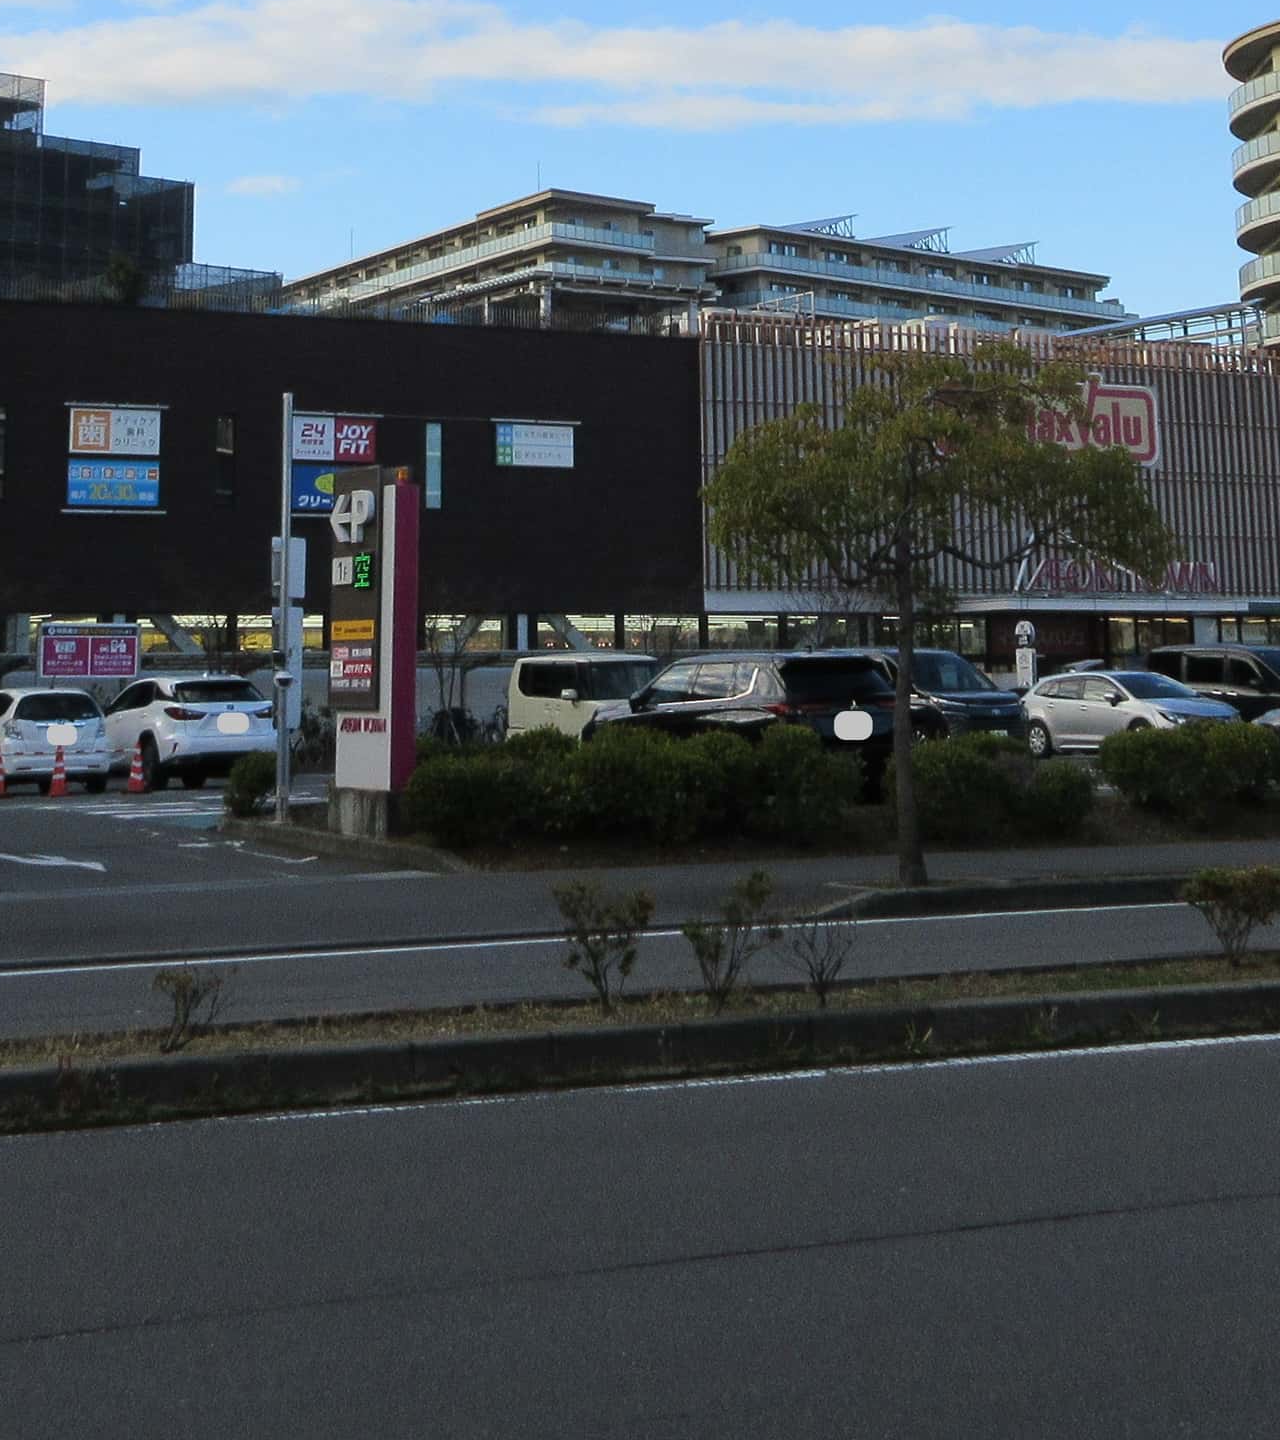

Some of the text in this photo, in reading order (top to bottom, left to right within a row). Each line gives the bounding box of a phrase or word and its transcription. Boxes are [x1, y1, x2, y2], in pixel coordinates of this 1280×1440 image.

[78, 414, 106, 448] 歯
[301, 424, 326, 438] 24
[336, 425, 374, 440] JOY
[339, 440, 370, 456] FIT
[299, 495, 334, 507] クリー
[353, 552, 371, 589] 空
